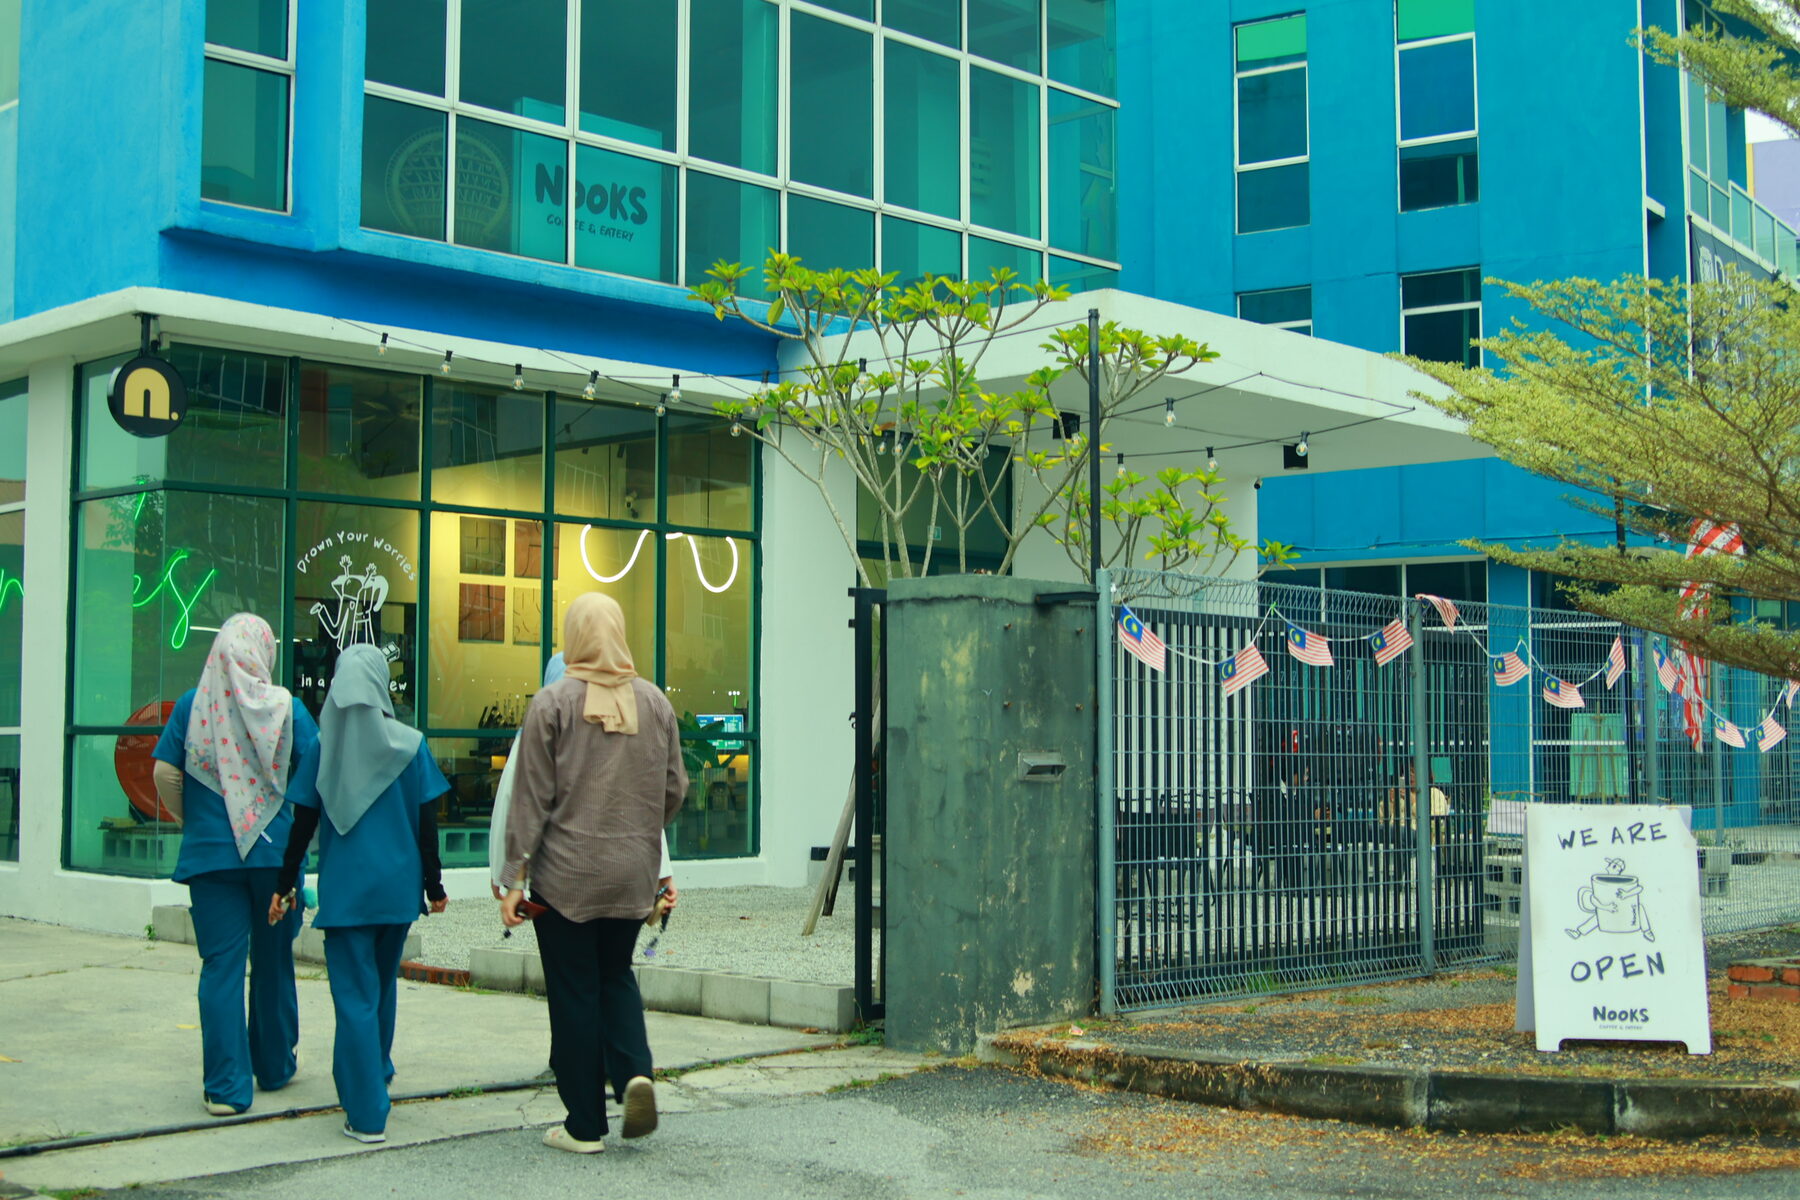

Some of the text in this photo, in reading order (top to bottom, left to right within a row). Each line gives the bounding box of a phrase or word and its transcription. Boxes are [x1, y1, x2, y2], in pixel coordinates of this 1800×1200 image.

[600, 225, 634, 242] EATERY
[296, 530, 416, 582] Drown Your Worries
[301, 673, 312, 688] in
[317, 678, 325, 688] a
[1557, 821, 1667, 850] WE ARE
[1570, 951, 1665, 982] OPEN
